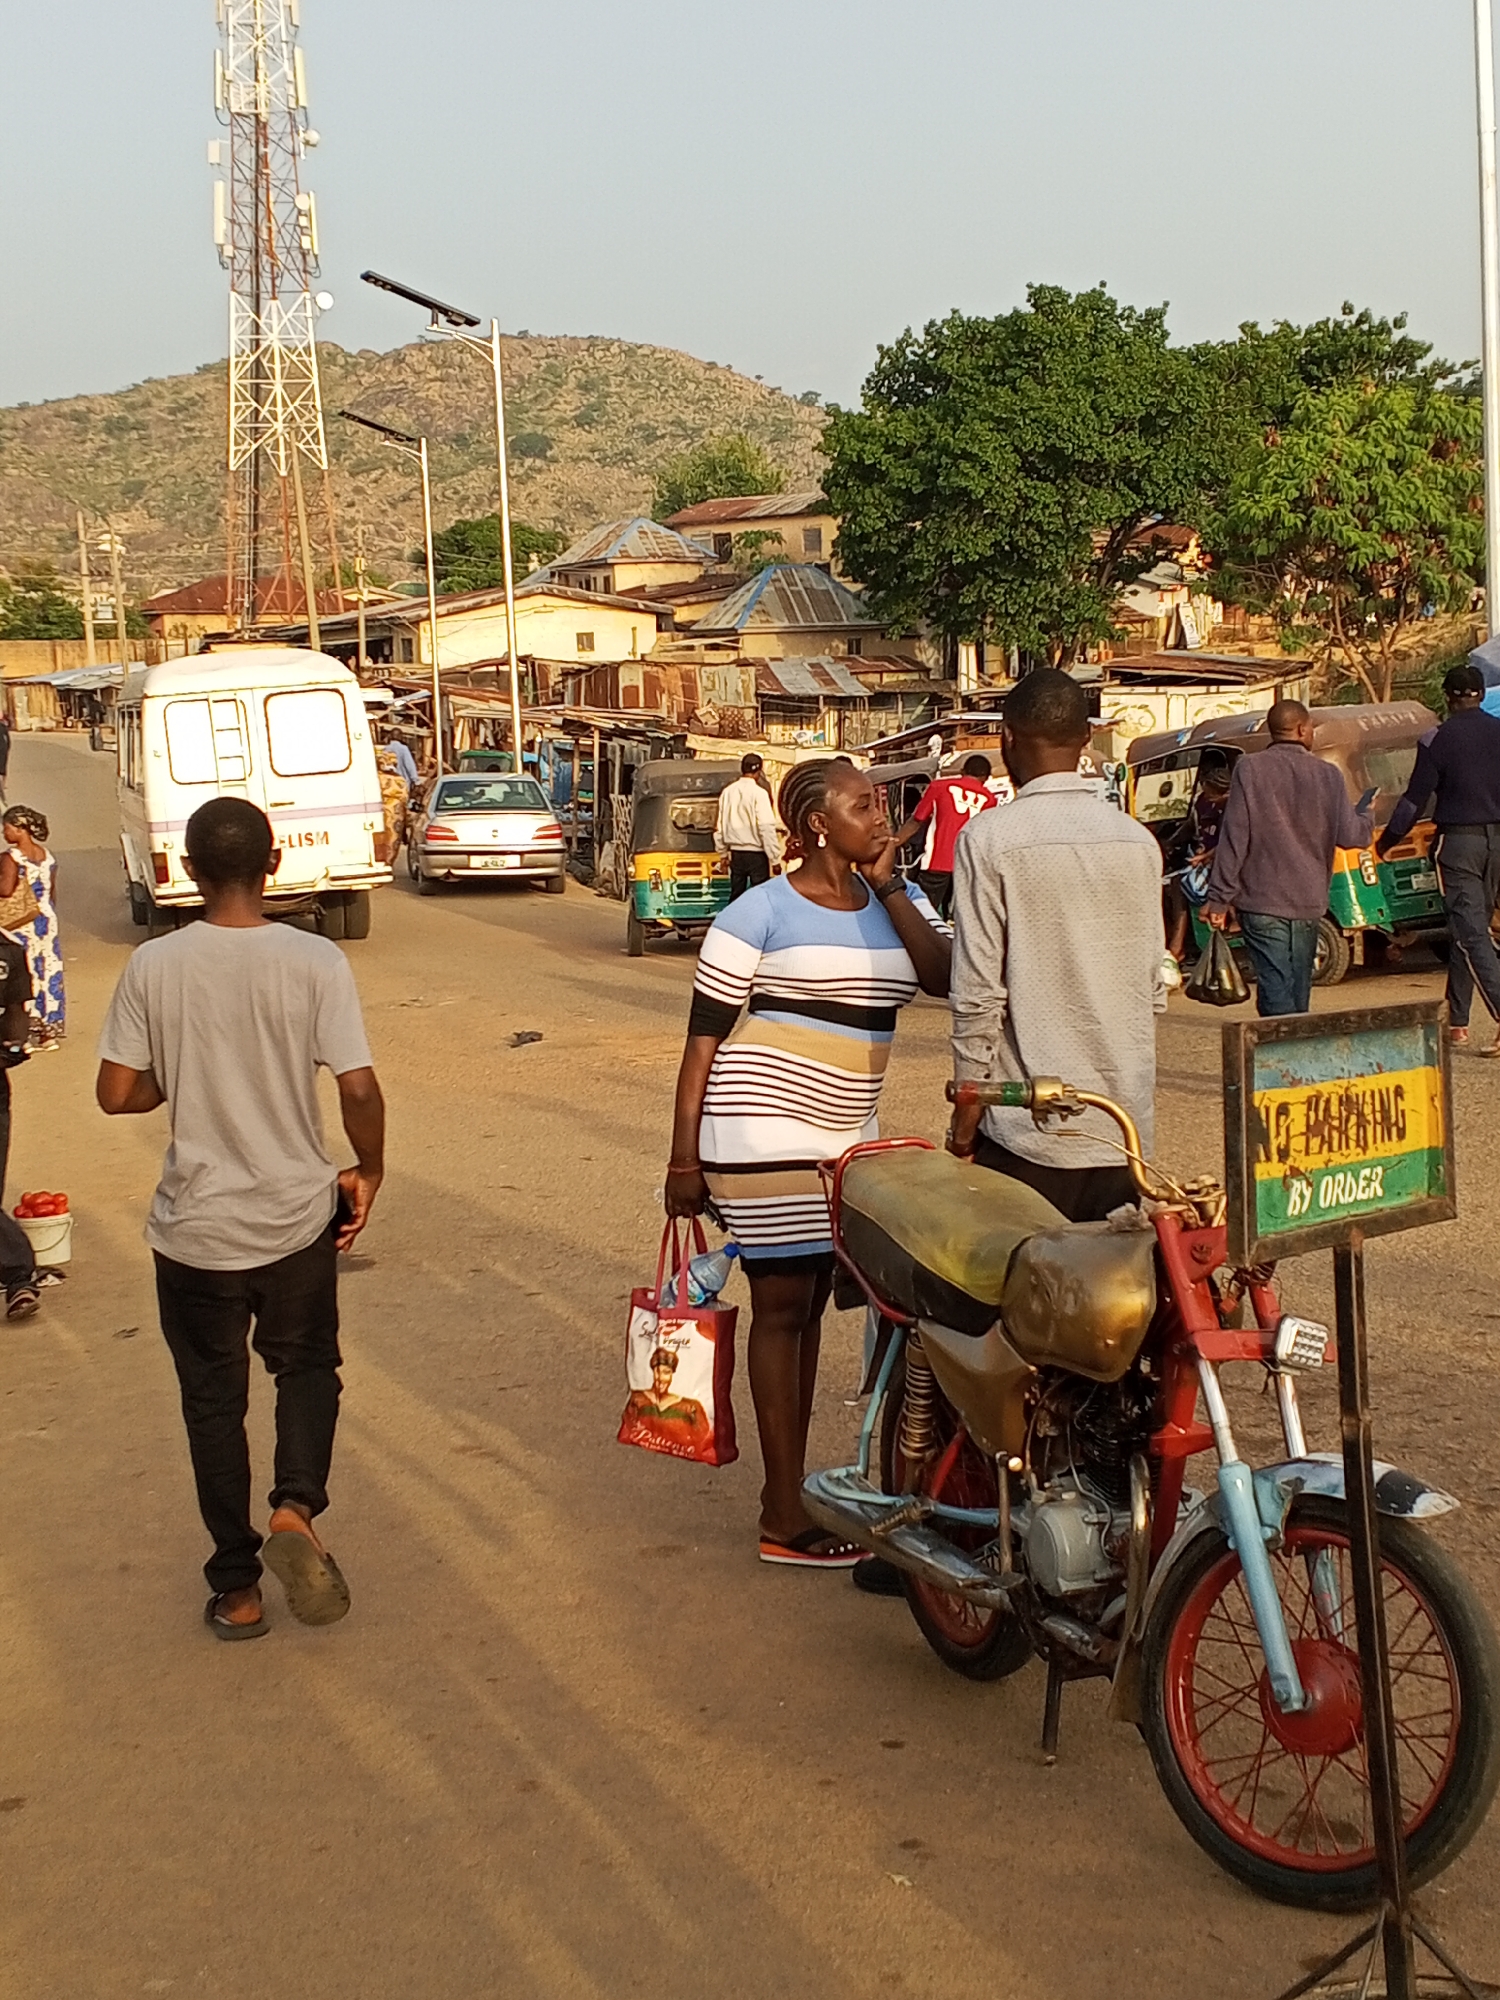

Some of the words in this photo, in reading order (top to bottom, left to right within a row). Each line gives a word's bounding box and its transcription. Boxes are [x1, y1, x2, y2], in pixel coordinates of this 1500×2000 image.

[278, 831, 329, 848] ELISM
[1305, 1084, 1407, 1157] PARKING
[1287, 1178, 1313, 1217] BY
[1319, 1165, 1384, 1210] ORDER
